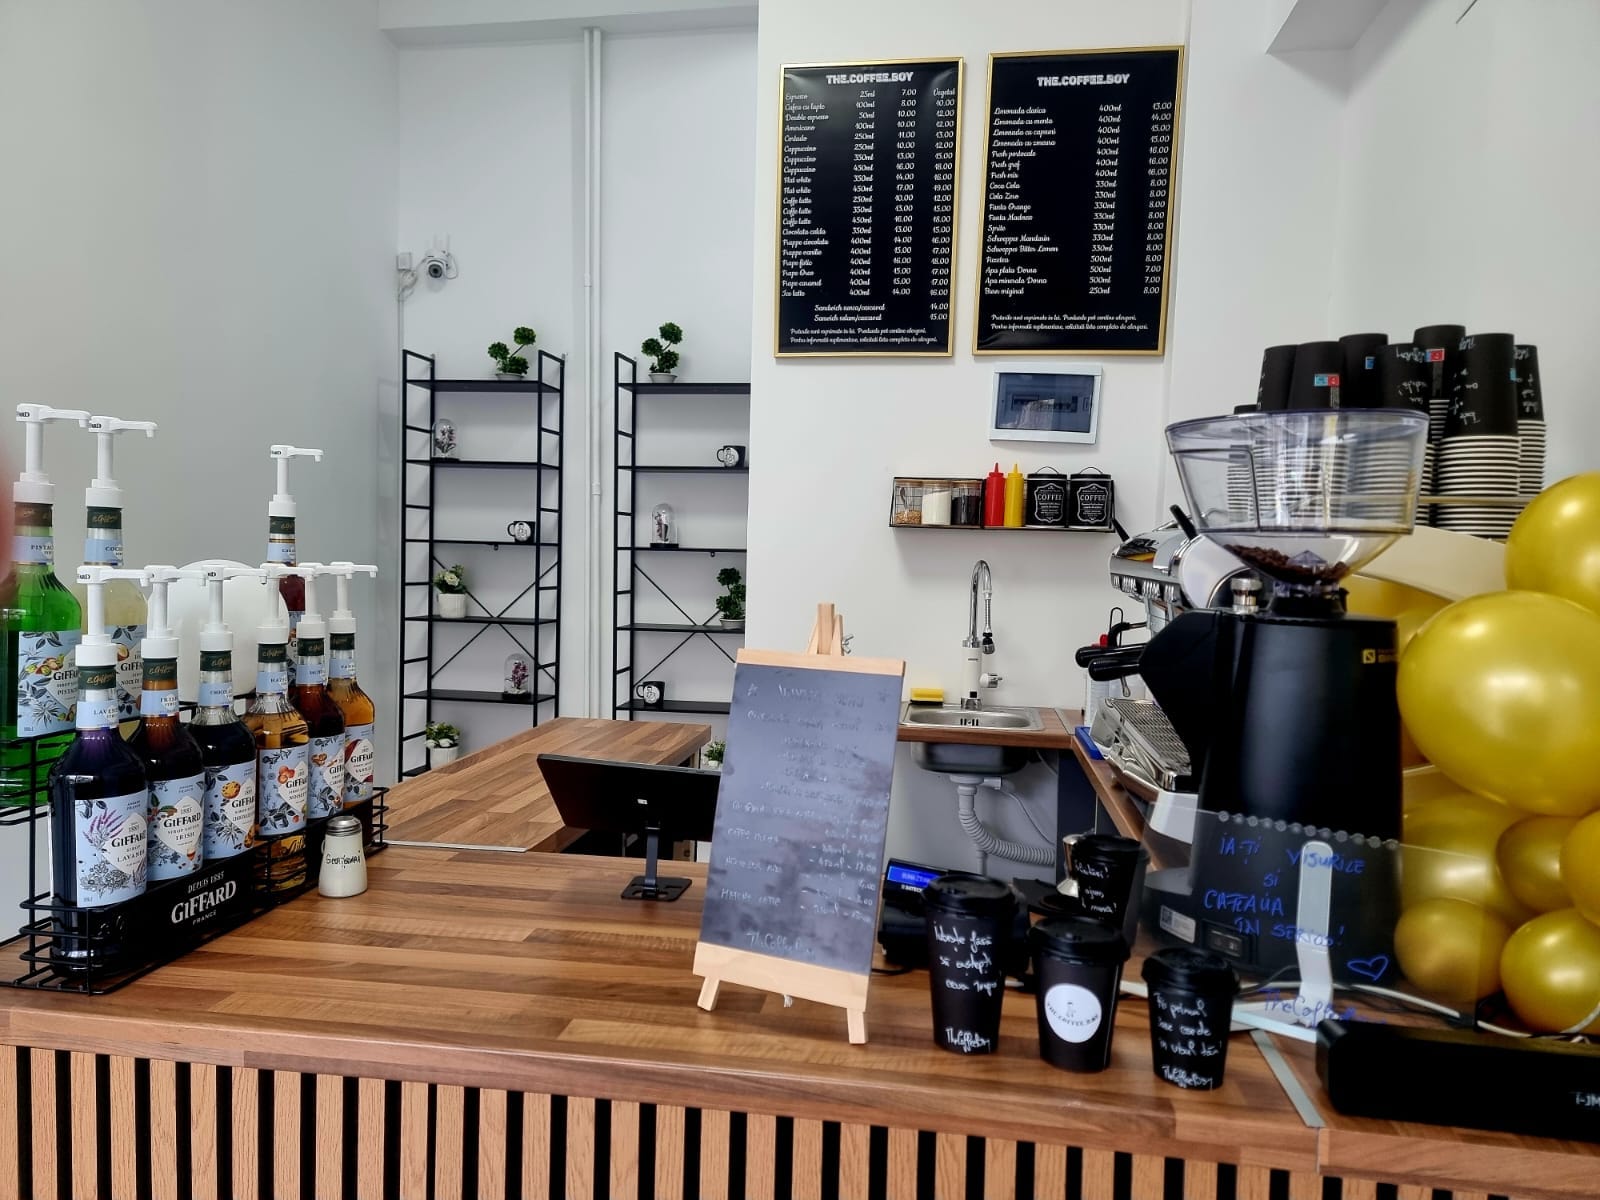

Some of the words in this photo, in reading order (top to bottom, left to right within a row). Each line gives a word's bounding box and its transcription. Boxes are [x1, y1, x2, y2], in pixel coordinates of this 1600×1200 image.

[826, 71, 914, 85] THE.COFFEE.BOY
[1037, 73, 1130, 87] THE.COFFEE.BOY
[901, 99, 917, 107] 8.00
[994, 106, 1025, 114] Limonada
[1099, 104, 1122, 112] 400ml
[786, 113, 806, 121] Double
[993, 117, 1024, 125] Limonada
[1099, 114, 1121, 122] 400ml
[1152, 113, 1171, 121] 14.00
[993, 128, 1024, 136] Limonada
[1098, 126, 1120, 134] 400ml
[1151, 124, 1171, 132] 15.00
[1097, 137, 1120, 145] 400ml
[1151, 135, 1170, 143] 15.00
[1150, 146, 1169, 154] 16.00
[1096, 158, 1118, 166] 400ml
[1149, 157, 1168, 165] 16.00
[1096, 169, 1118, 177] 400ml
[1148, 168, 1168, 176] 16.00
[1006, 181, 1020, 189] Cola
[1096, 180, 1117, 188] 330ml
[989, 192, 1003, 200] Cola
[1005, 192, 1019, 200] Zero
[1095, 191, 1116, 199] 330ml
[1150, 190, 1166, 198] 8.00
[989, 203, 1007, 211] Fanta
[1008, 203, 1031, 213] Orange
[1094, 201, 1116, 209] 330ml
[1149, 200, 1165, 208] 8.00
[1093, 212, 1115, 220] 330ml
[1148, 211, 1165, 219] 8.00
[988, 224, 1006, 234] Sprite
[1093, 223, 1114, 231] 330ml
[1148, 222, 1164, 230] 8.00
[1092, 233, 1114, 241] 330ml
[1092, 244, 1113, 252] 330ml
[1146, 254, 1162, 262] 8.00
[986, 267, 998, 276] Apa
[999, 266, 1015, 276] plata
[1090, 265, 1112, 273] 500ml
[1145, 265, 1161, 273] 7.00
[985, 277, 998, 286] Apa
[1089, 276, 1111, 284] 500ml
[1089, 286, 1111, 294] 250ml
[1144, 286, 1160, 294] 8.00
[164, 811, 201, 828] GIFFARD
[176, 831, 196, 841] IRISH
[188, 879, 209, 894] DEPUIS
[211, 870, 225, 885] 1885
[171, 880, 237, 925] GIFFARD
[193, 911, 217, 926] FRANCE
